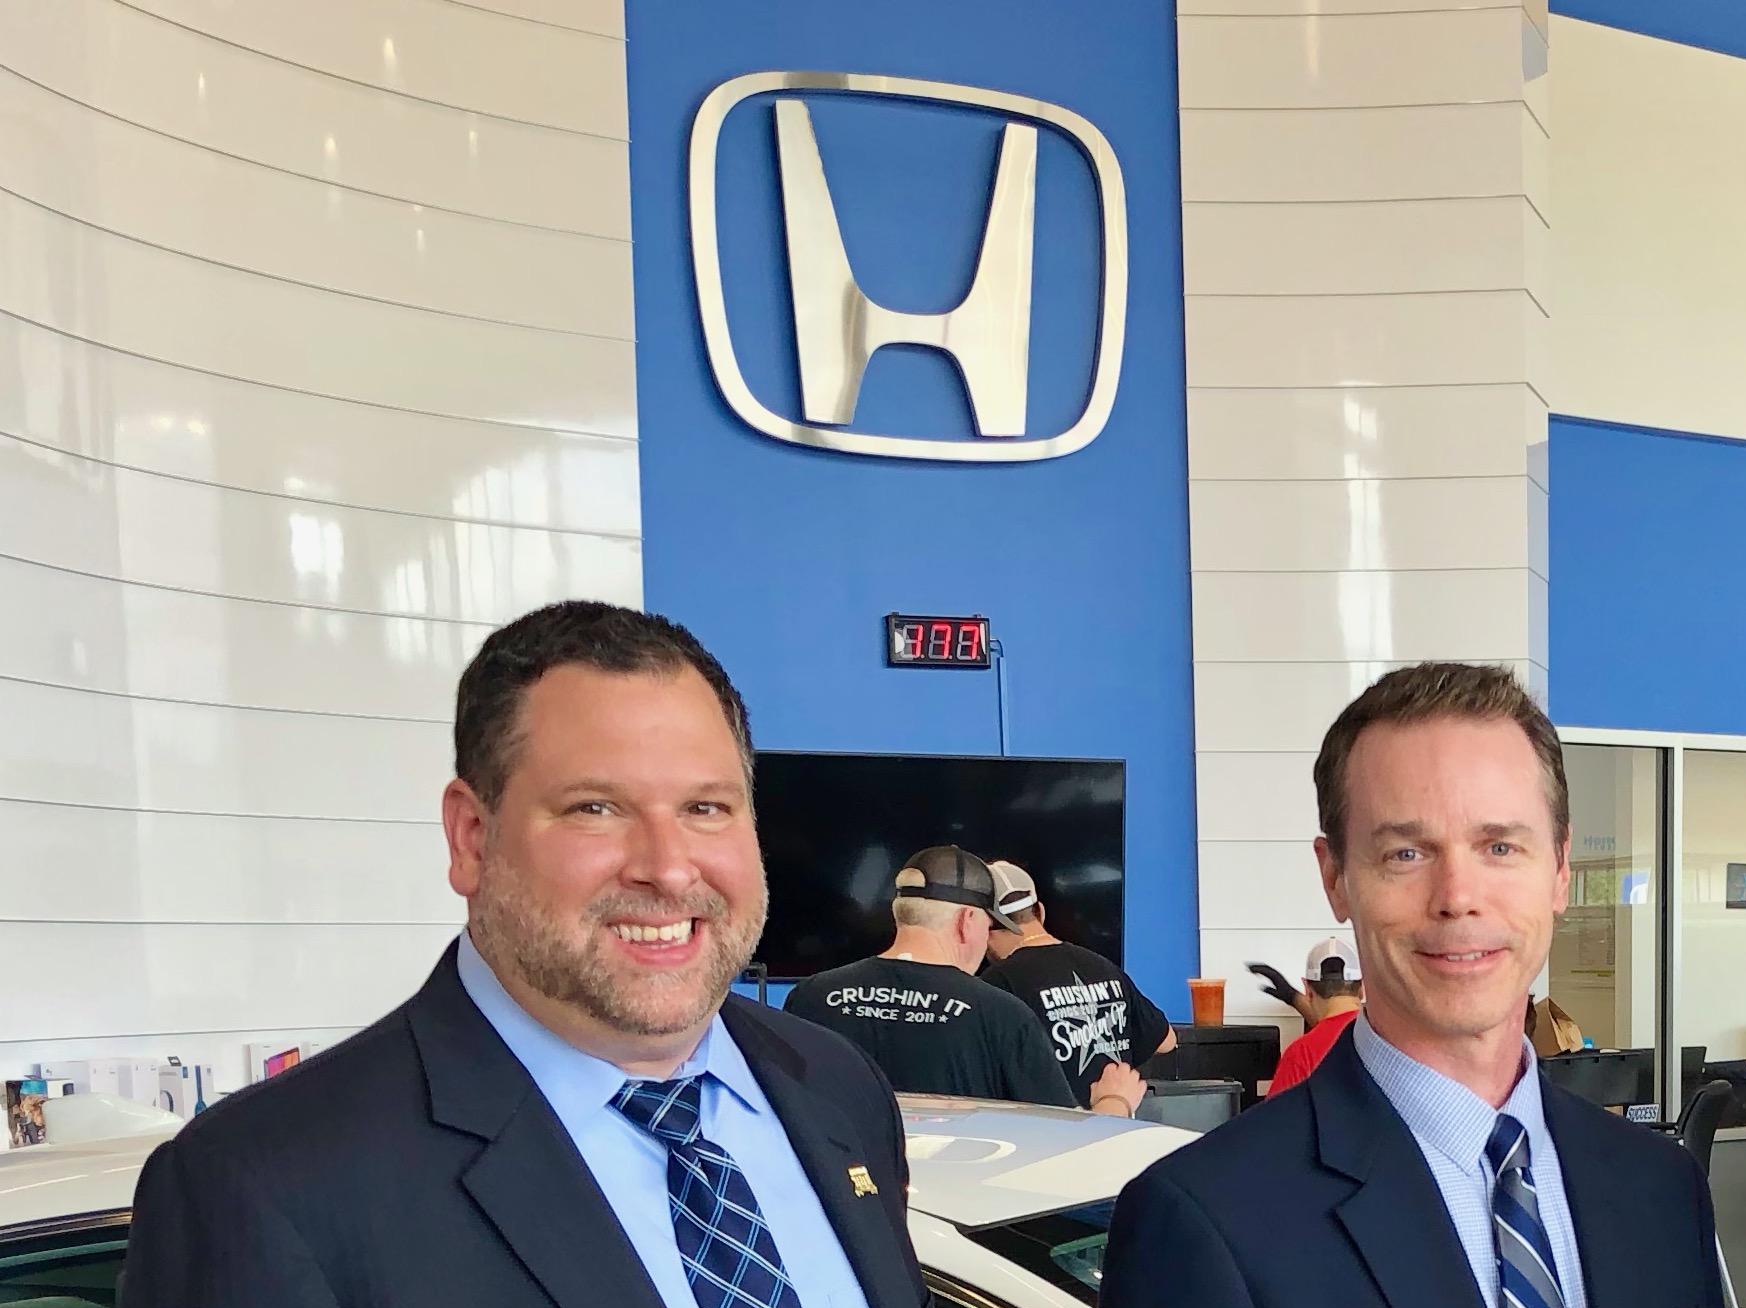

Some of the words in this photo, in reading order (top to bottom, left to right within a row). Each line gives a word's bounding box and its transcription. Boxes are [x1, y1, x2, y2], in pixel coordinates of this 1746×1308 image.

[826, 986, 940, 1008] CRUSHIN'
[943, 998, 972, 1017] IT
[1040, 981, 1109, 1010] CRUSHIN'
[855, 1005, 900, 1021] SINCE
[904, 1011, 935, 1024] 2011
